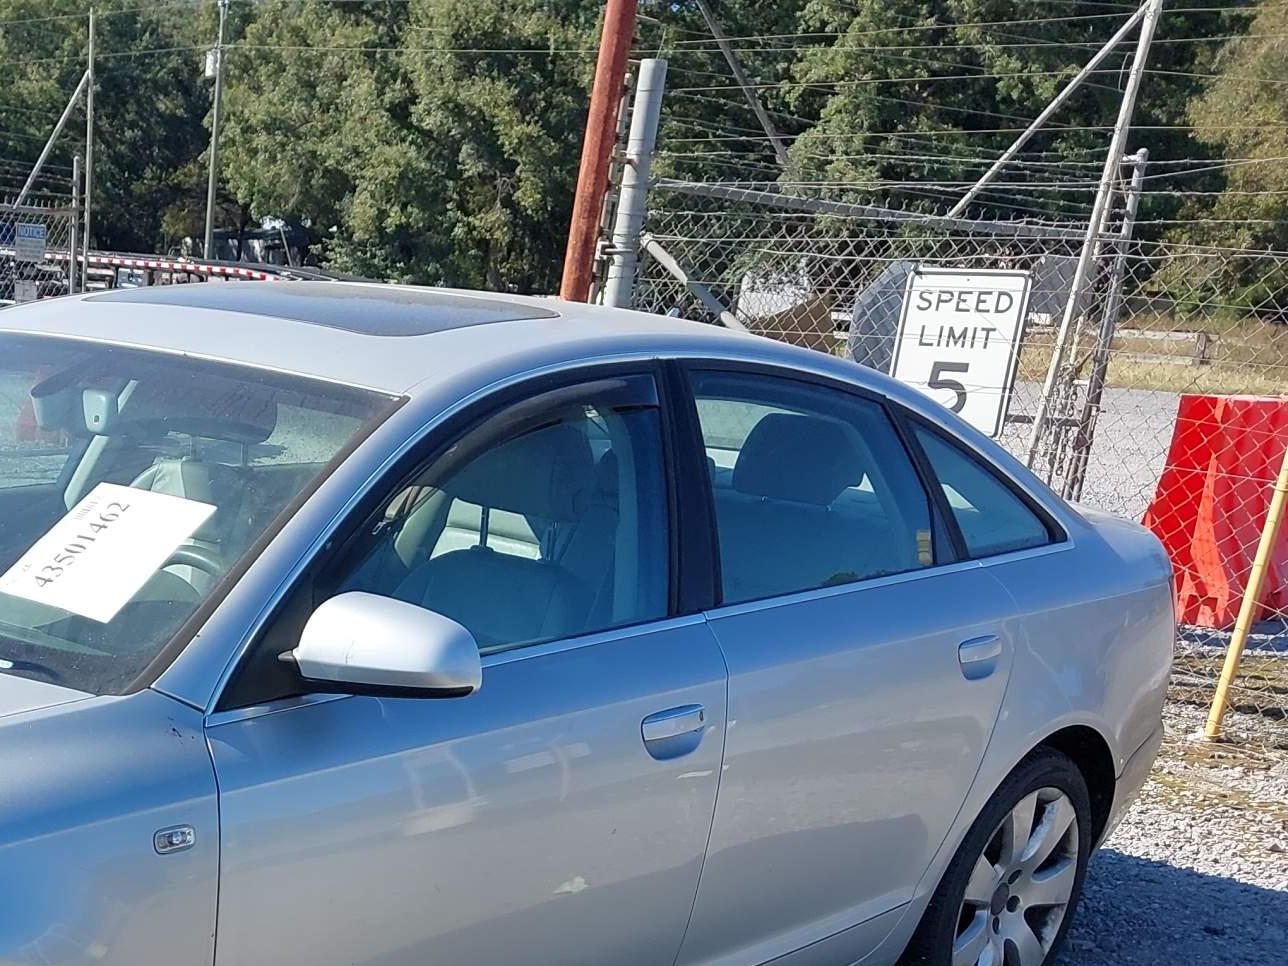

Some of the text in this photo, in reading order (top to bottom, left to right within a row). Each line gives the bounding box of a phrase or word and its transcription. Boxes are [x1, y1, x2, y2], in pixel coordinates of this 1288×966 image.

[916, 289, 1014, 313] SPEED
[918, 325, 997, 349] LIMIT
[928, 361, 970, 413] 5
[34, 502, 131, 588] 43501462
